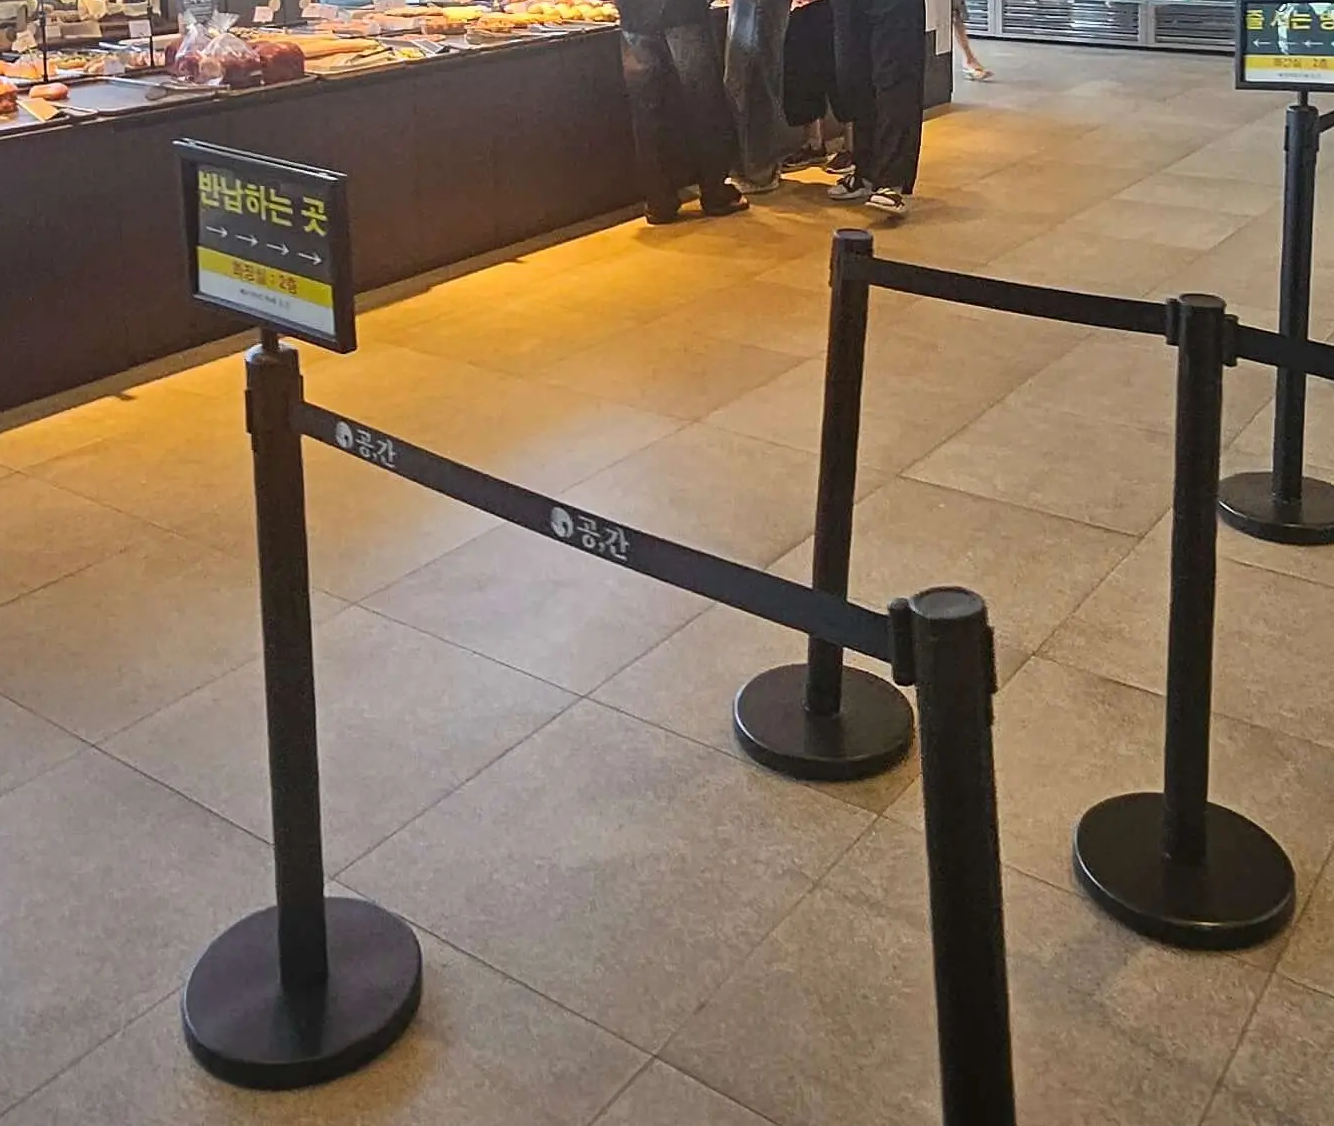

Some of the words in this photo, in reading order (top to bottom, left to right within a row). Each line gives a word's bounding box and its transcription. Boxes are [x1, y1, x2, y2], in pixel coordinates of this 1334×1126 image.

[1246, 9, 1264, 30] 줄
[198, 170, 294, 227] 반납하는
[301, 196, 328, 237] 곳
